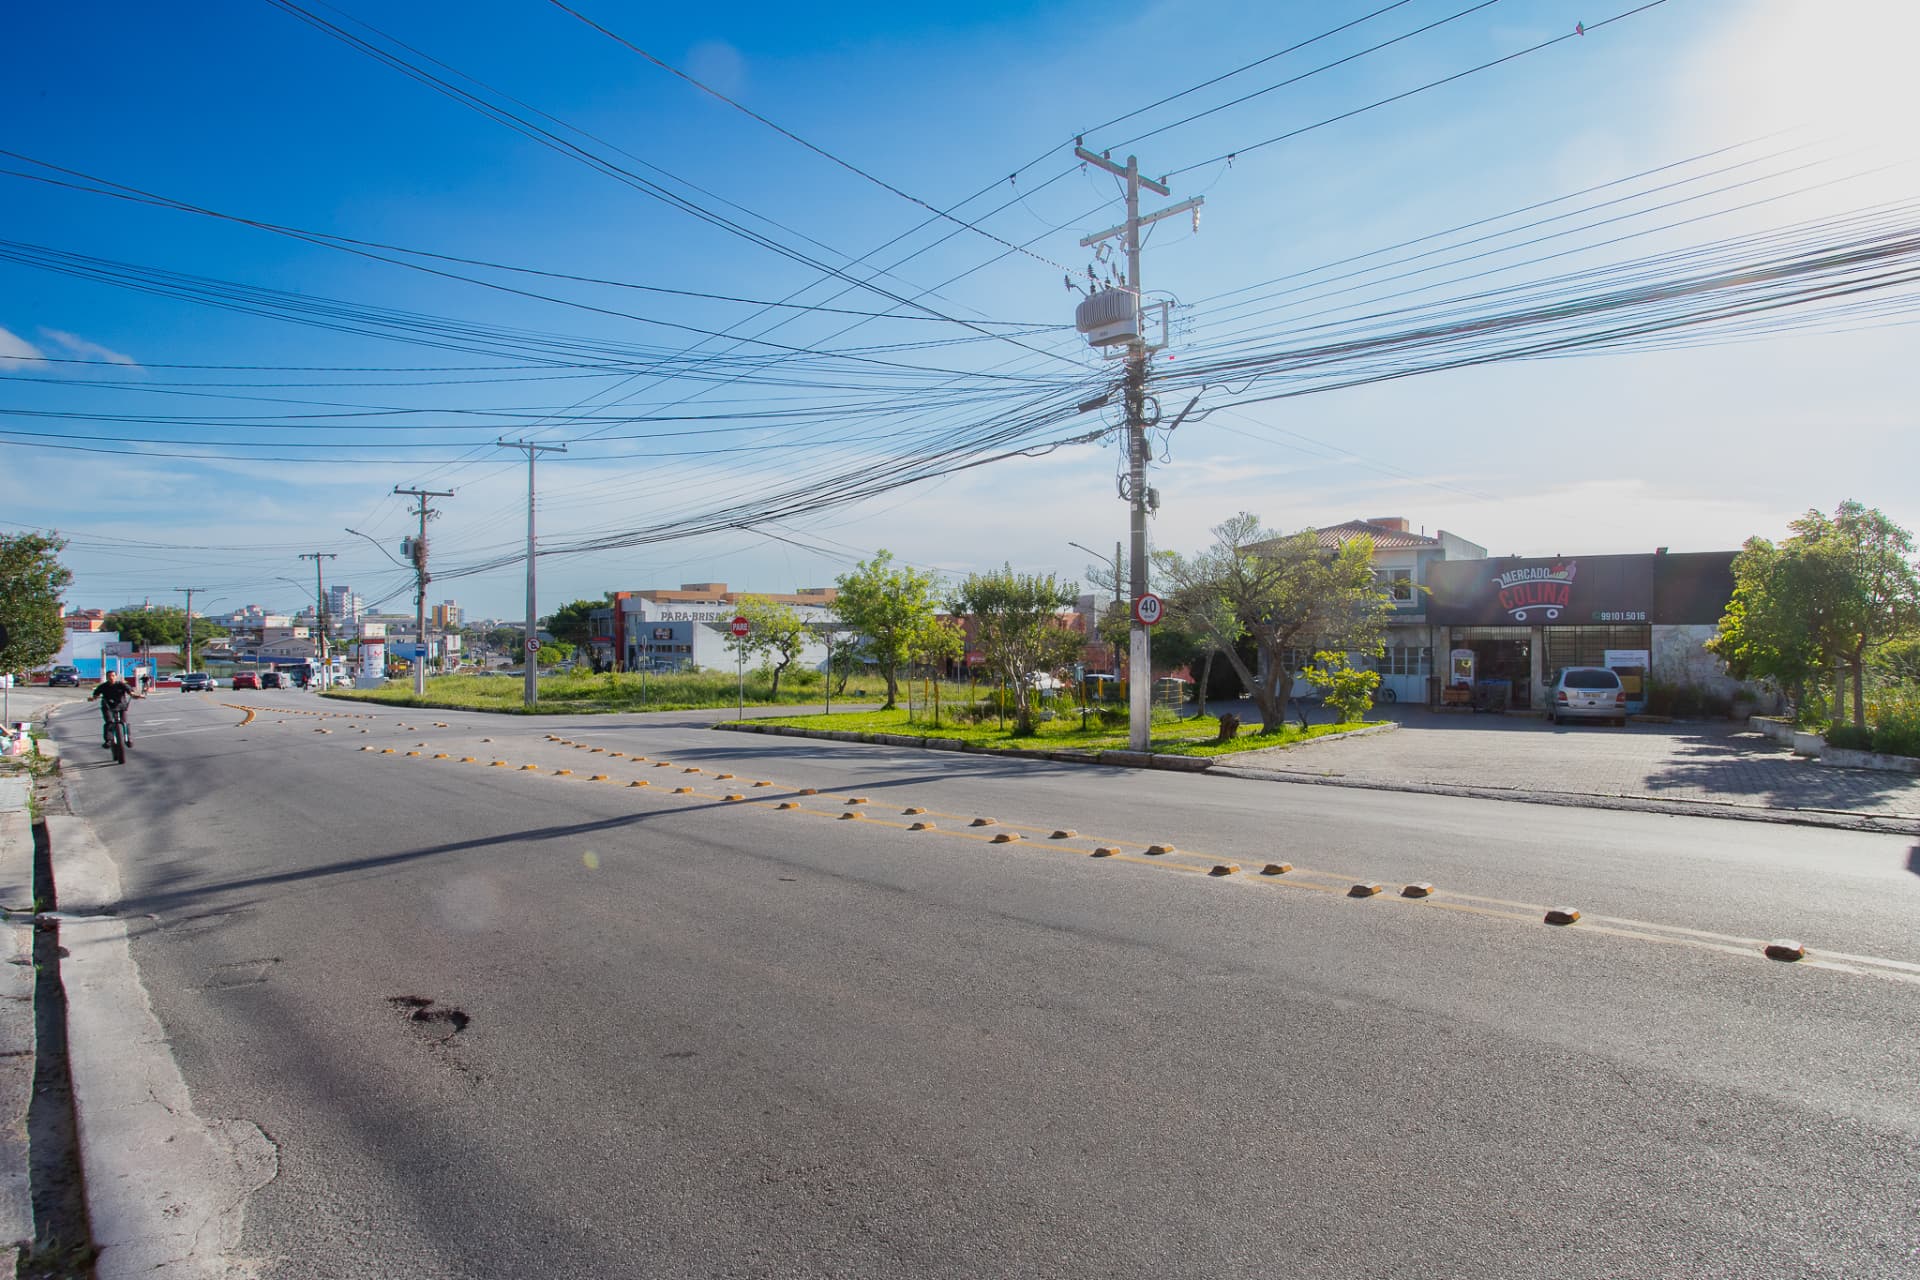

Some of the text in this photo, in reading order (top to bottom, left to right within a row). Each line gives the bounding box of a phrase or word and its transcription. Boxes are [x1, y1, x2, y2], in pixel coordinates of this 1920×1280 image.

[1501, 567, 1550, 584] MERCADO
[1498, 582, 1570, 609] COLINA
[1141, 599, 1157, 613] 40
[1601, 611, 1646, 621] 99101.5016
[732, 623, 747, 631] PARE
